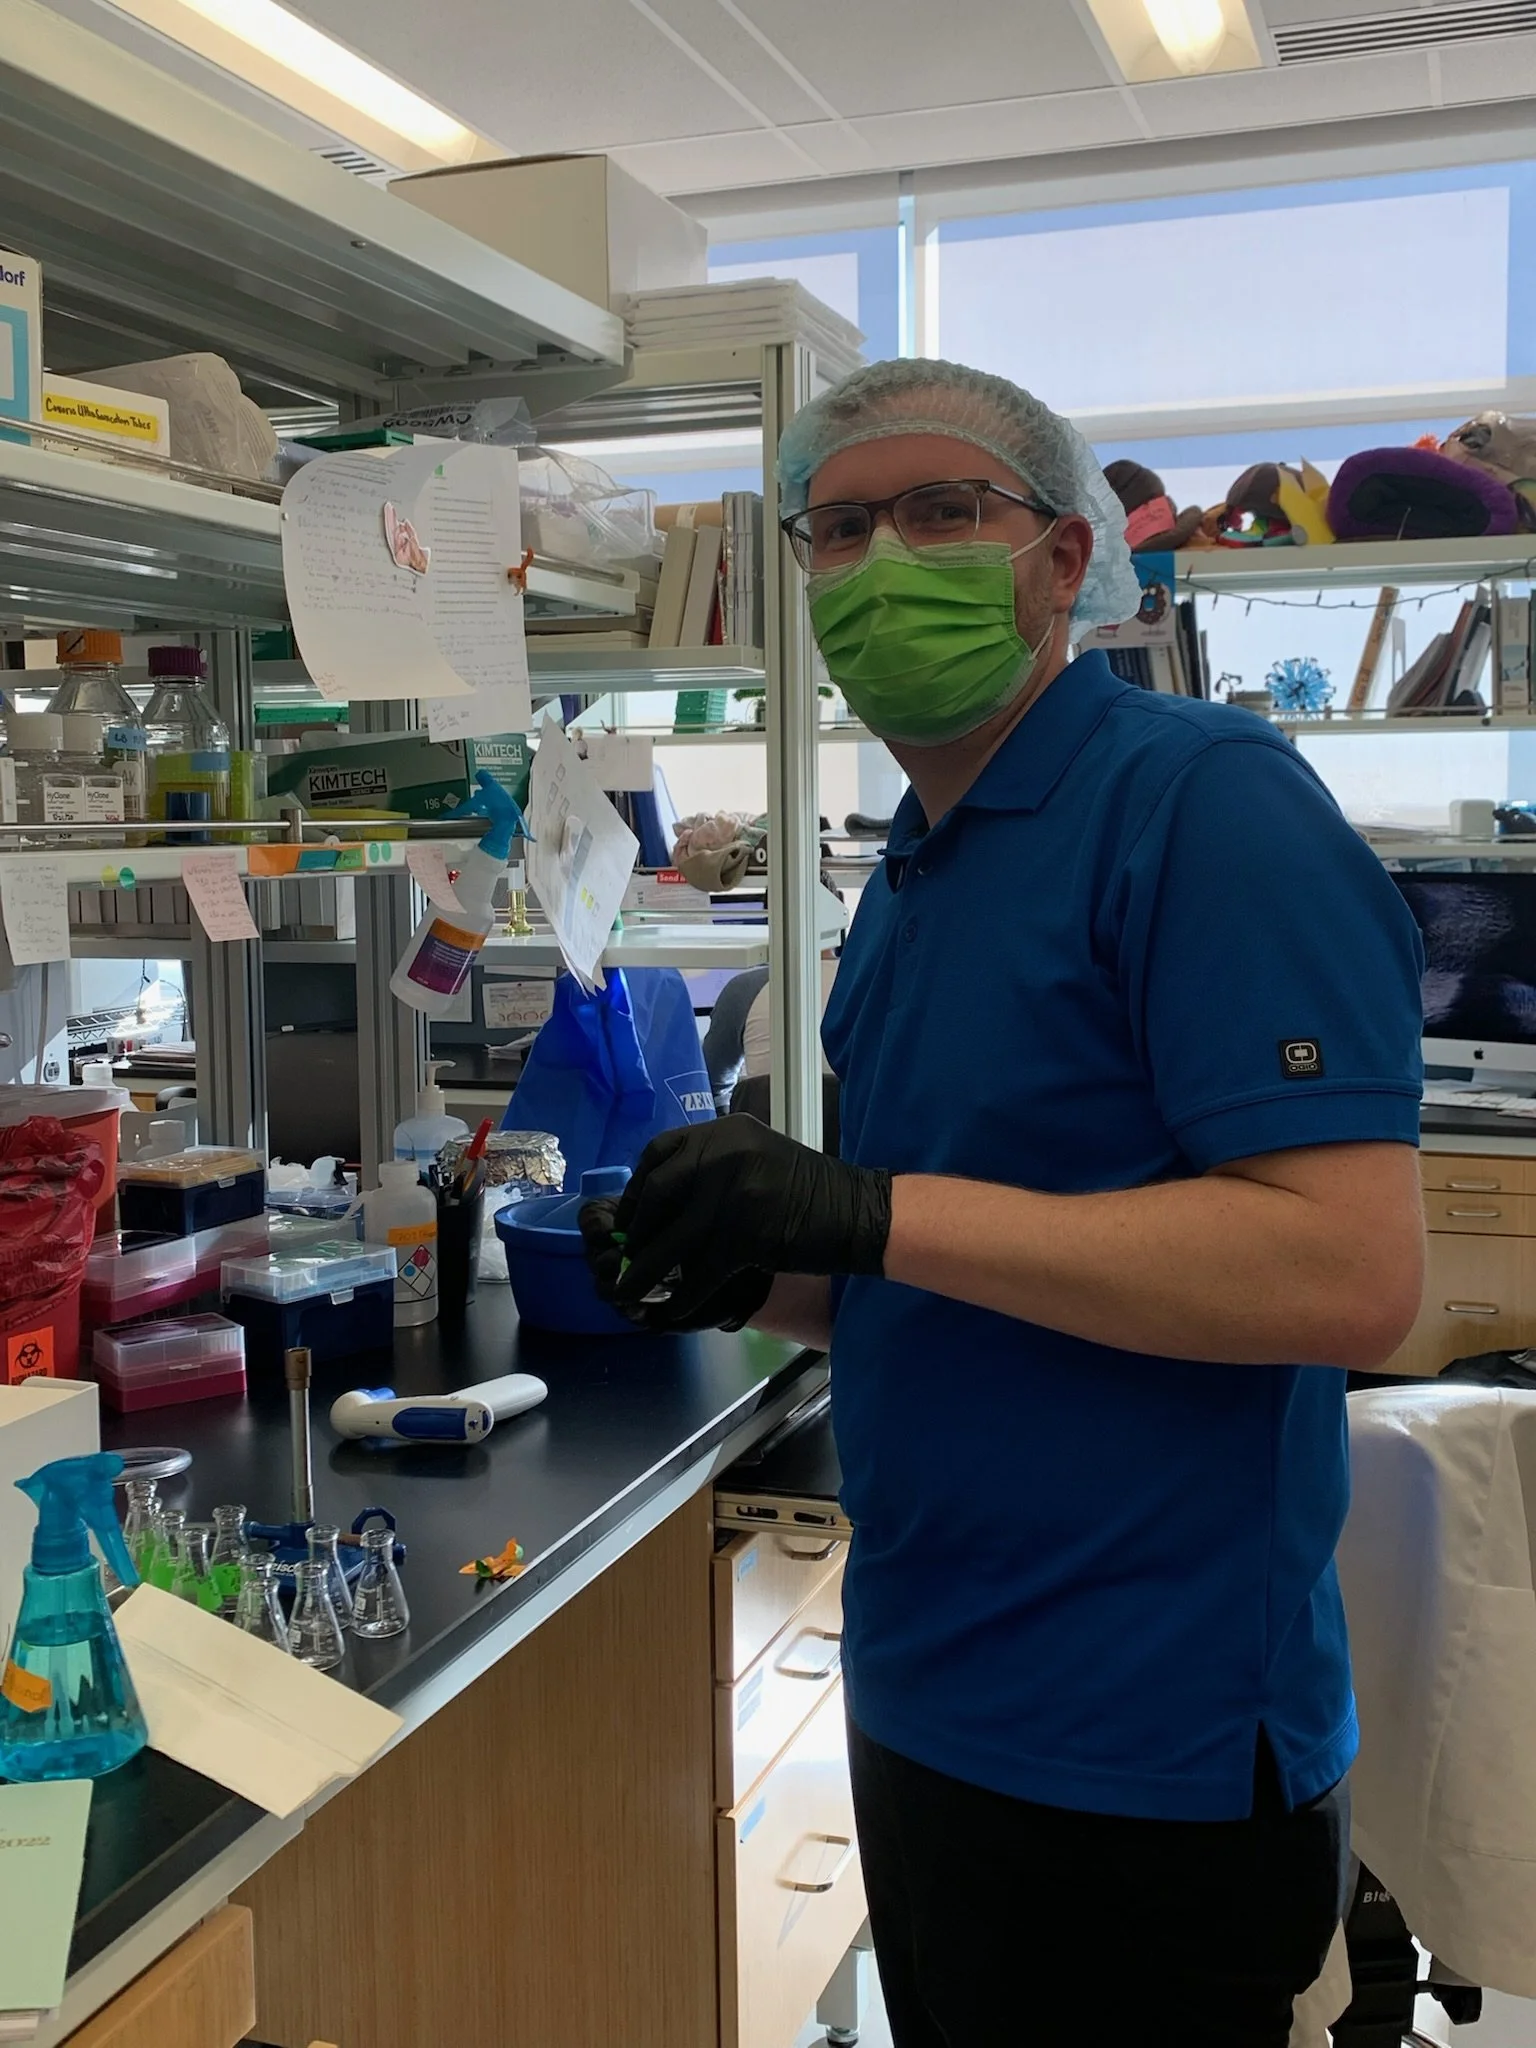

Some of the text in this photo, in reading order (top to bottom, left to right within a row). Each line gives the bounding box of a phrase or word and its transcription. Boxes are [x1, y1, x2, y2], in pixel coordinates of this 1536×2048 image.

[0, 265, 25, 286] orf
[474, 743, 522, 757] KIMTECH
[309, 768, 386, 791] KIMTECH
